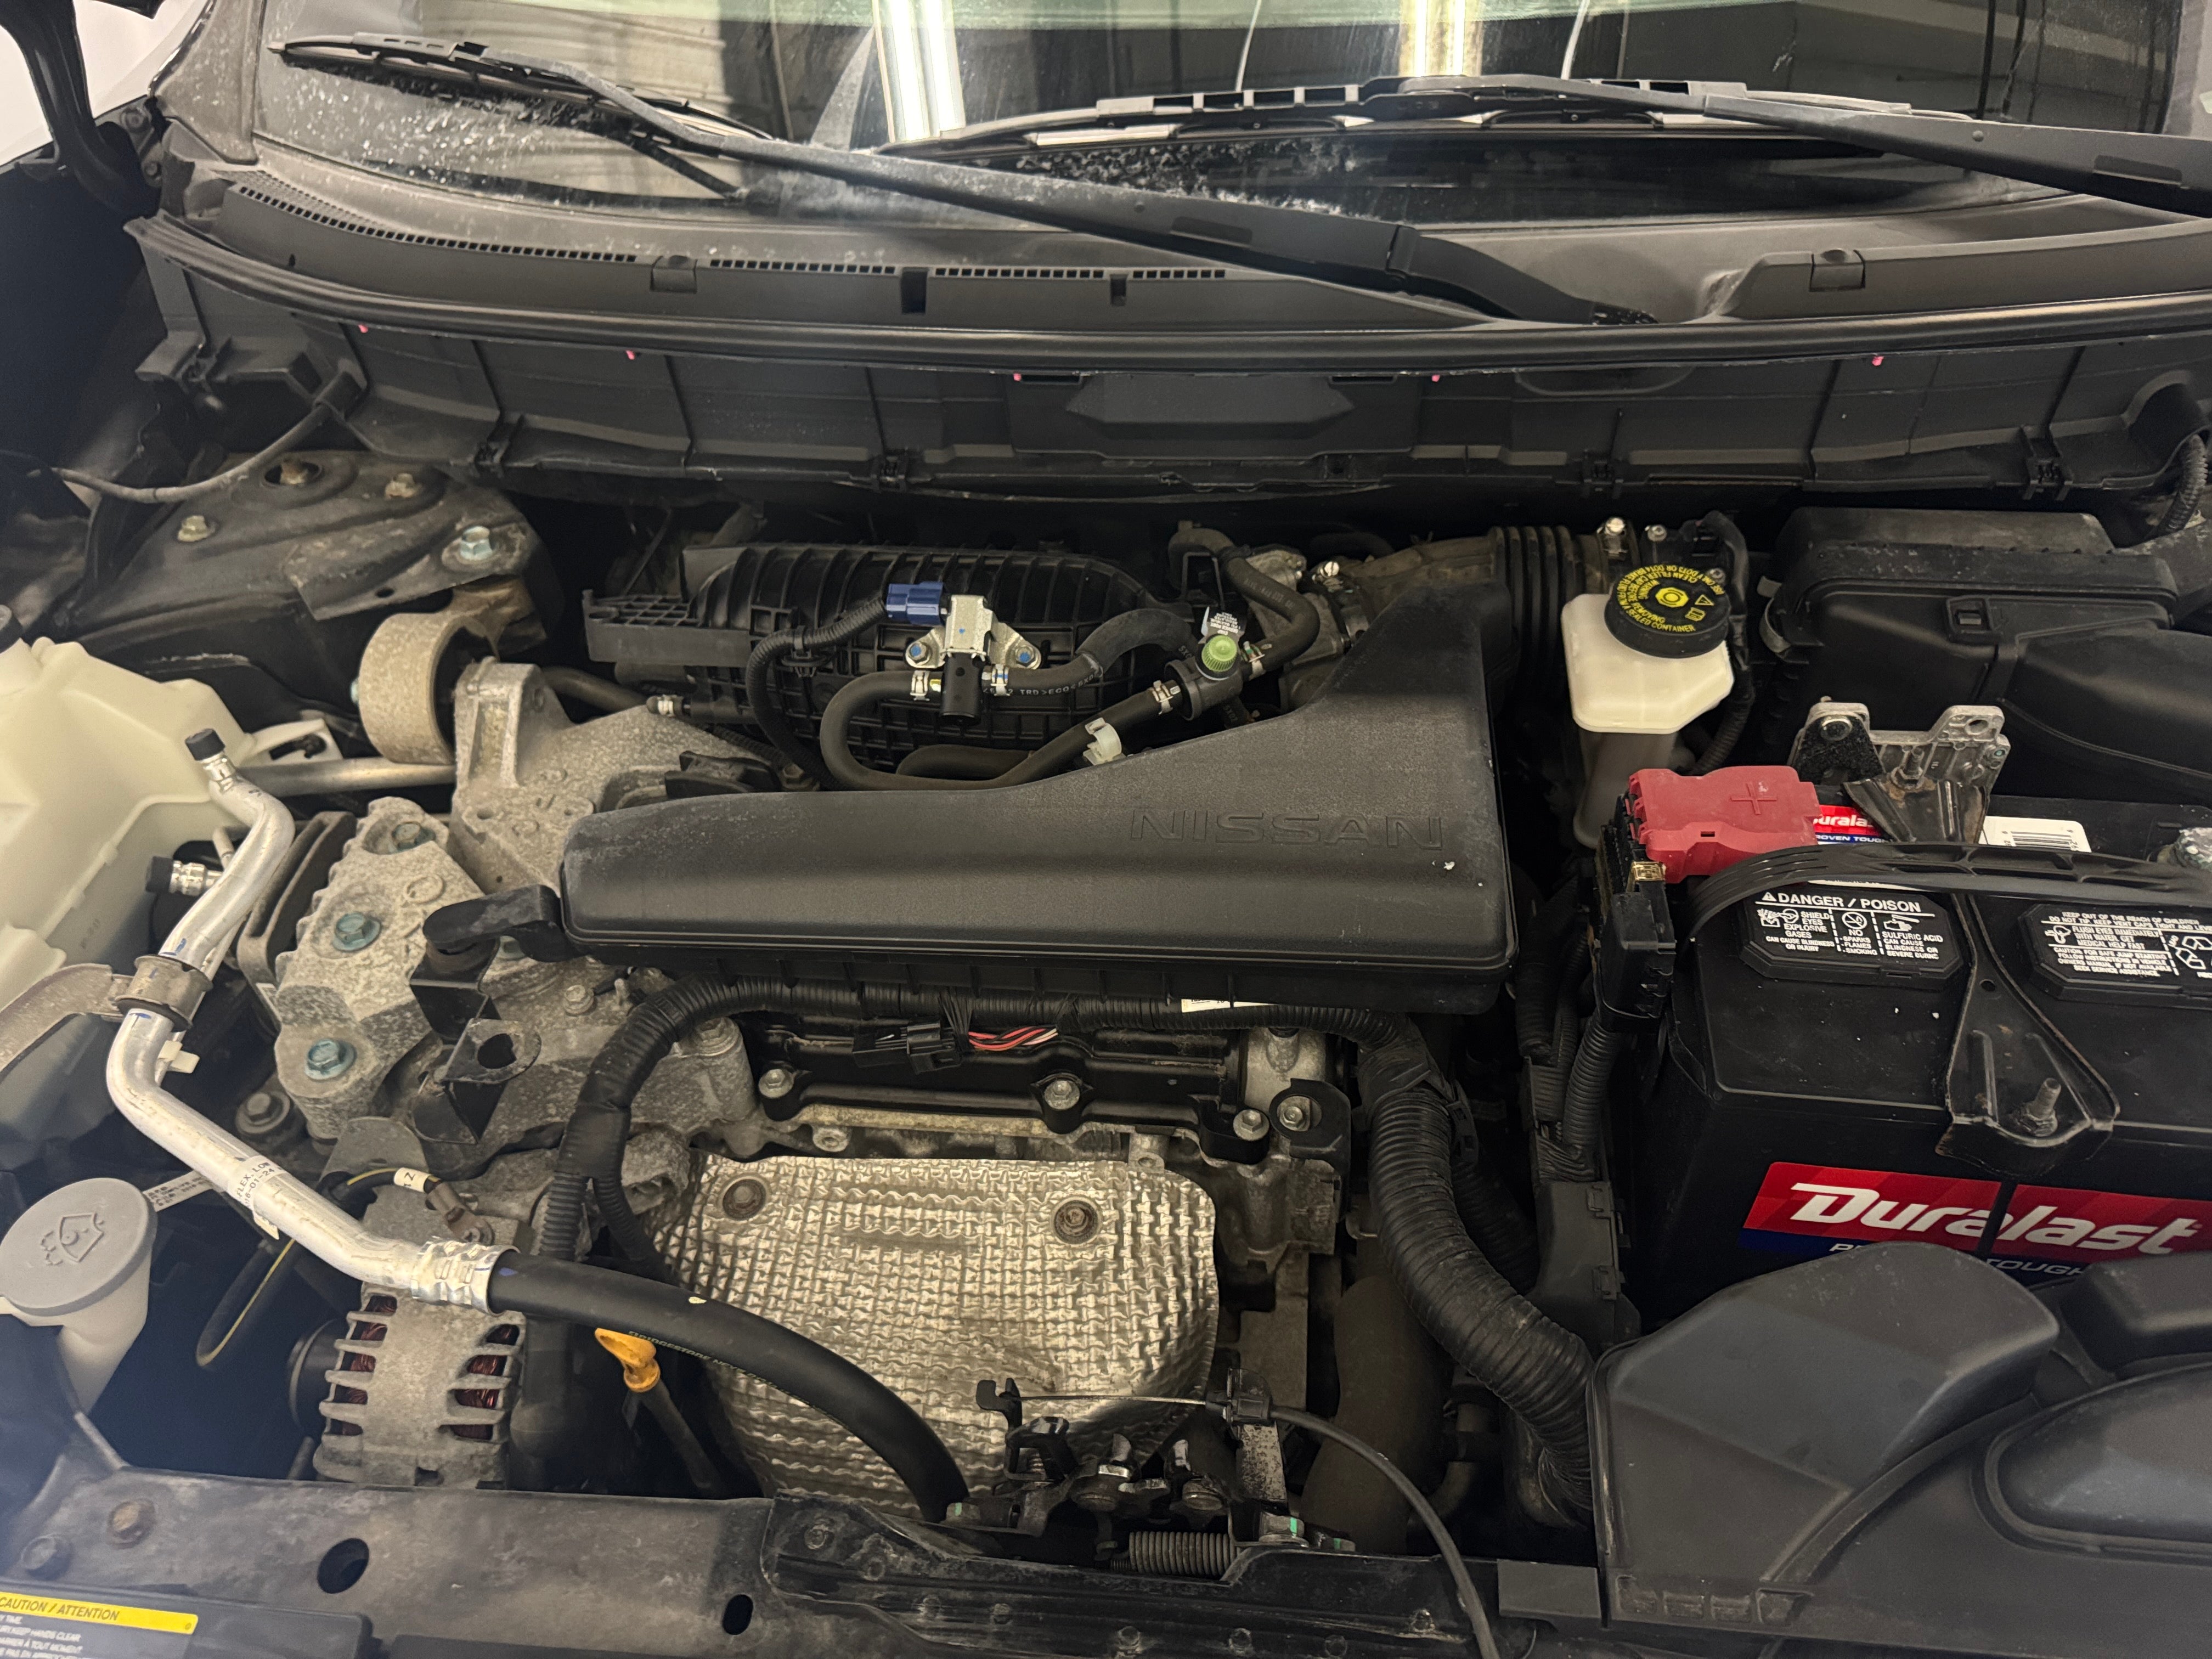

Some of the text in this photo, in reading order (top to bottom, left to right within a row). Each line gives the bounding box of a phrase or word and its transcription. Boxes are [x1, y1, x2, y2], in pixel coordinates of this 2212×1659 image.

[1626, 609, 1651, 625] SEALED
[1651, 622, 1696, 632] CONTAINER
[1631, 602, 1665, 623] REMOVING
[1131, 810, 1443, 850] NISSAN
[1778, 893, 1921, 912] DANGER / POISON
[1801, 911, 1830, 920] SHIELD
[1784, 923, 1828, 933] EXPLOSIVE
[1785, 930, 1813, 939] GASES
[1882, 931, 1944, 943] SULFURIC ACID
[1885, 944, 1925, 952] BLINDNESS
[1791, 1183, 2198, 1255] Duralast
[0, 1596, 48, 1612] CAUTION
[57, 1605, 120, 1621] ATTENTION
